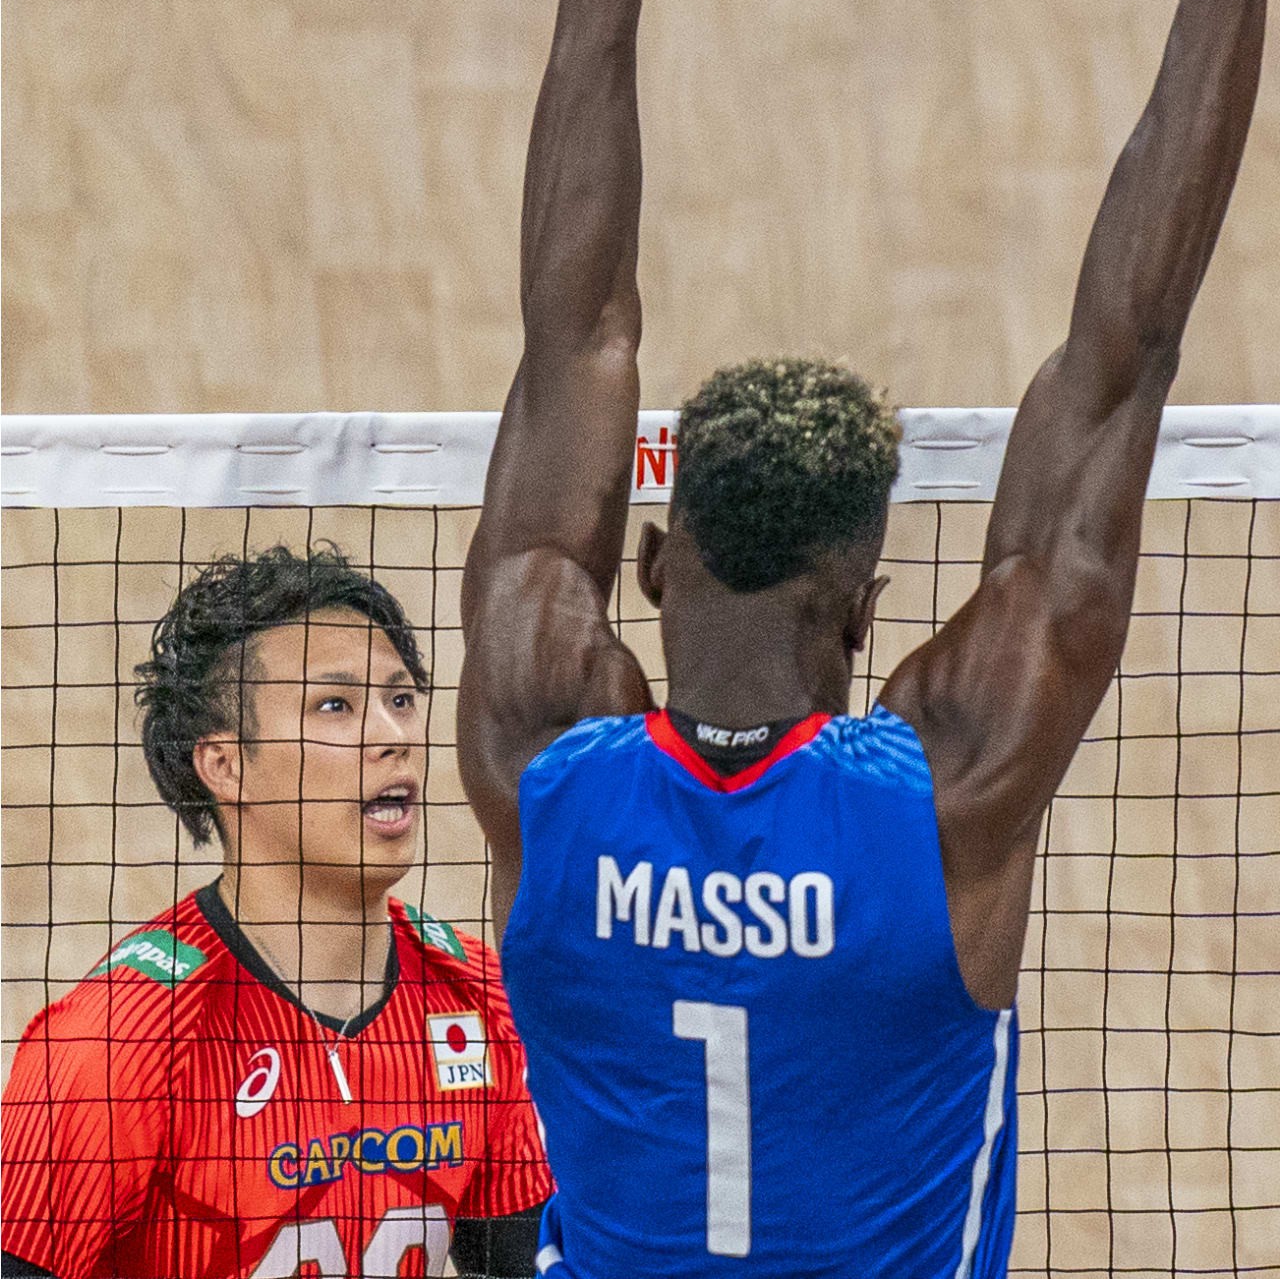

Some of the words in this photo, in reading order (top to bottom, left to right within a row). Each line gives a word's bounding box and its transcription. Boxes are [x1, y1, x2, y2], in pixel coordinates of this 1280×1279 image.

[596, 855, 835, 958] MASSO
[447, 1063, 486, 1085] JPN
[268, 1121, 464, 1190] CAPCOM
[672, 999, 752, 1258] 1
